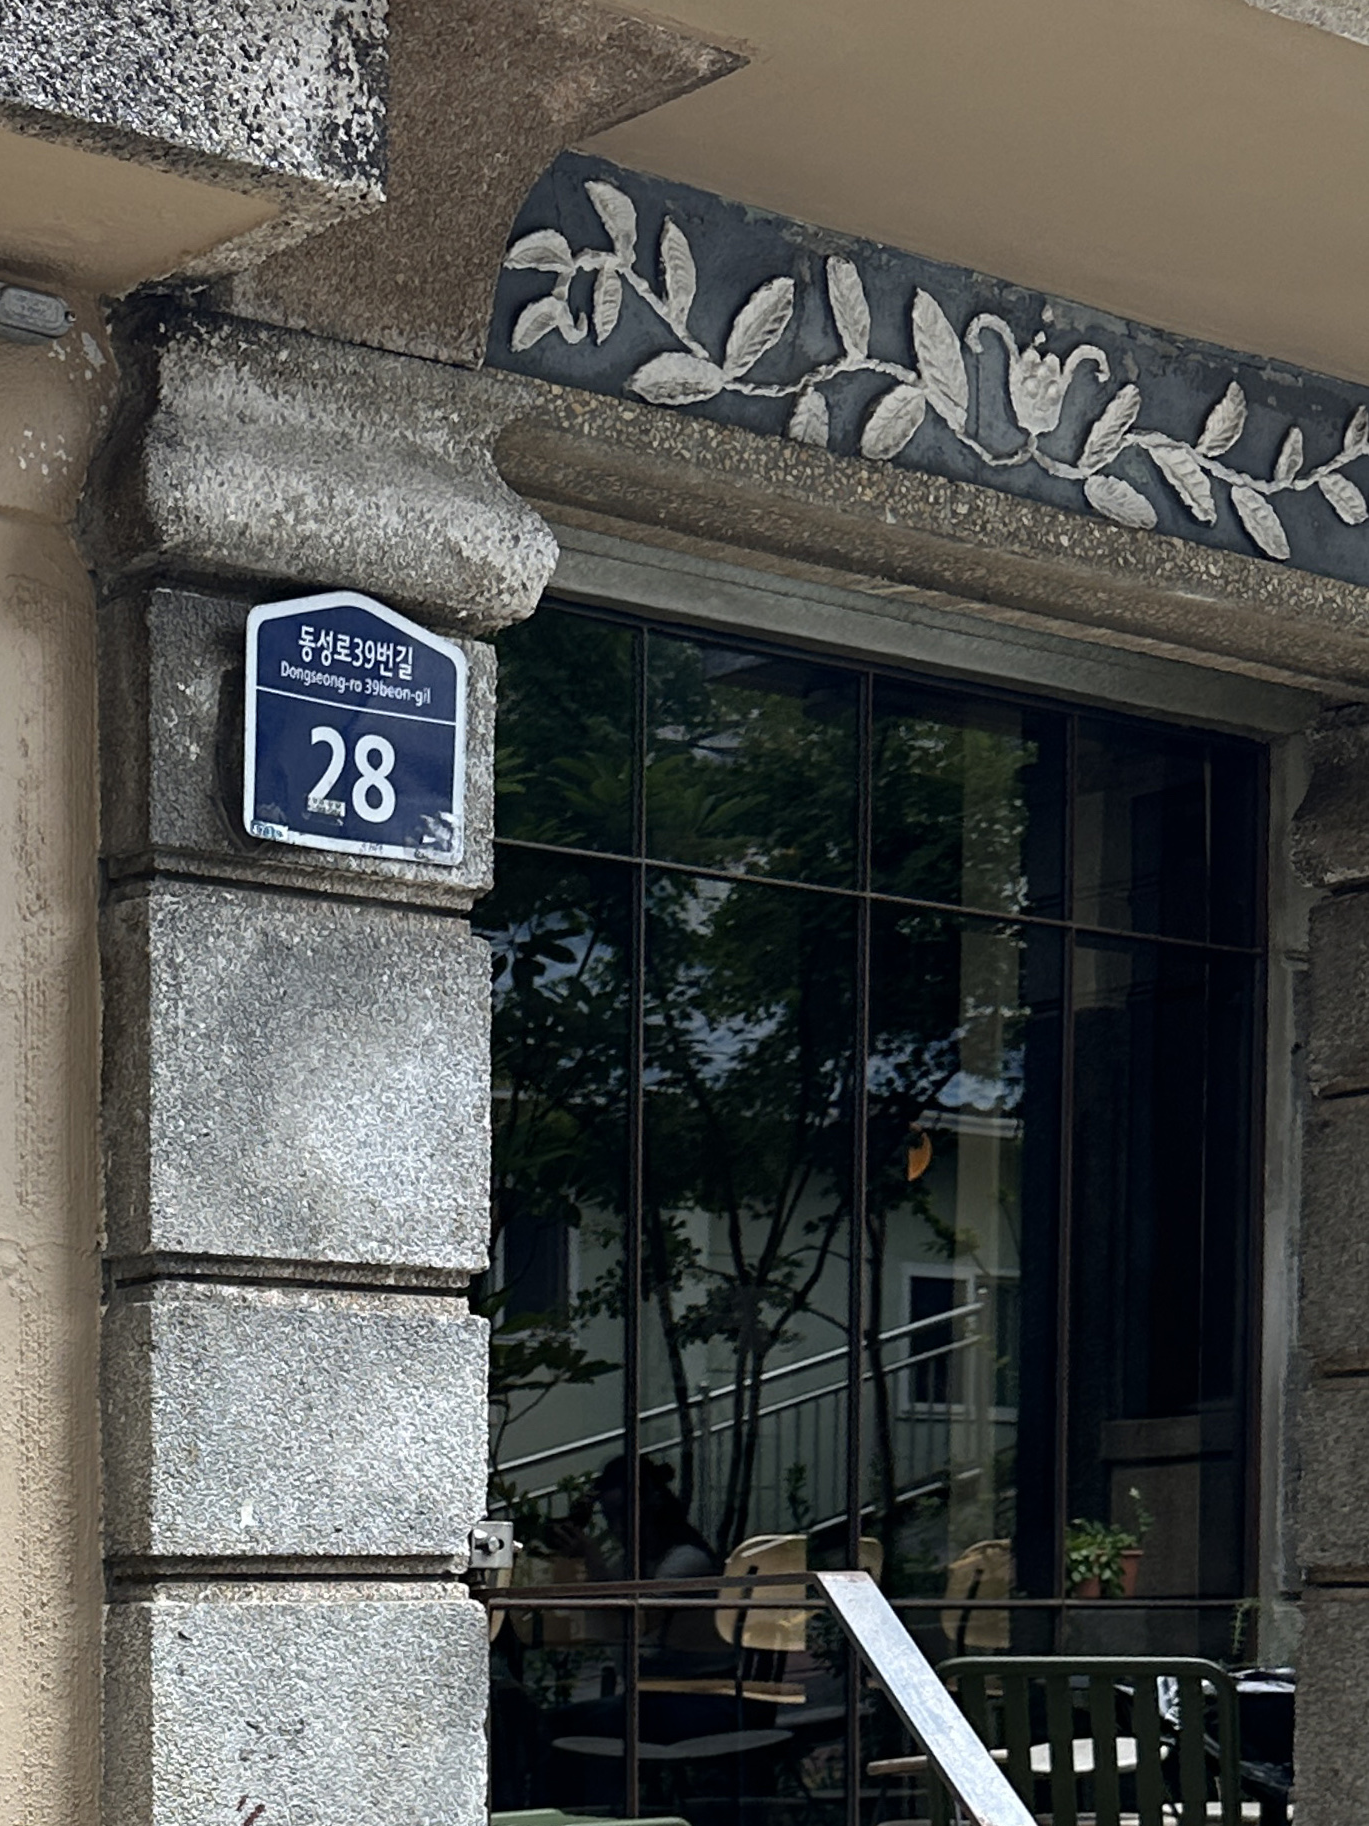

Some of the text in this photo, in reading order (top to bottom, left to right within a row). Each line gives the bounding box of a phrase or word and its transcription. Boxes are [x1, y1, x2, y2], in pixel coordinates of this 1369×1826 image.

[298, 624, 413, 681] 동성로39번길
[280, 660, 431, 707] Dongseong-ro 39beon-gil
[306, 725, 397, 824] 28
